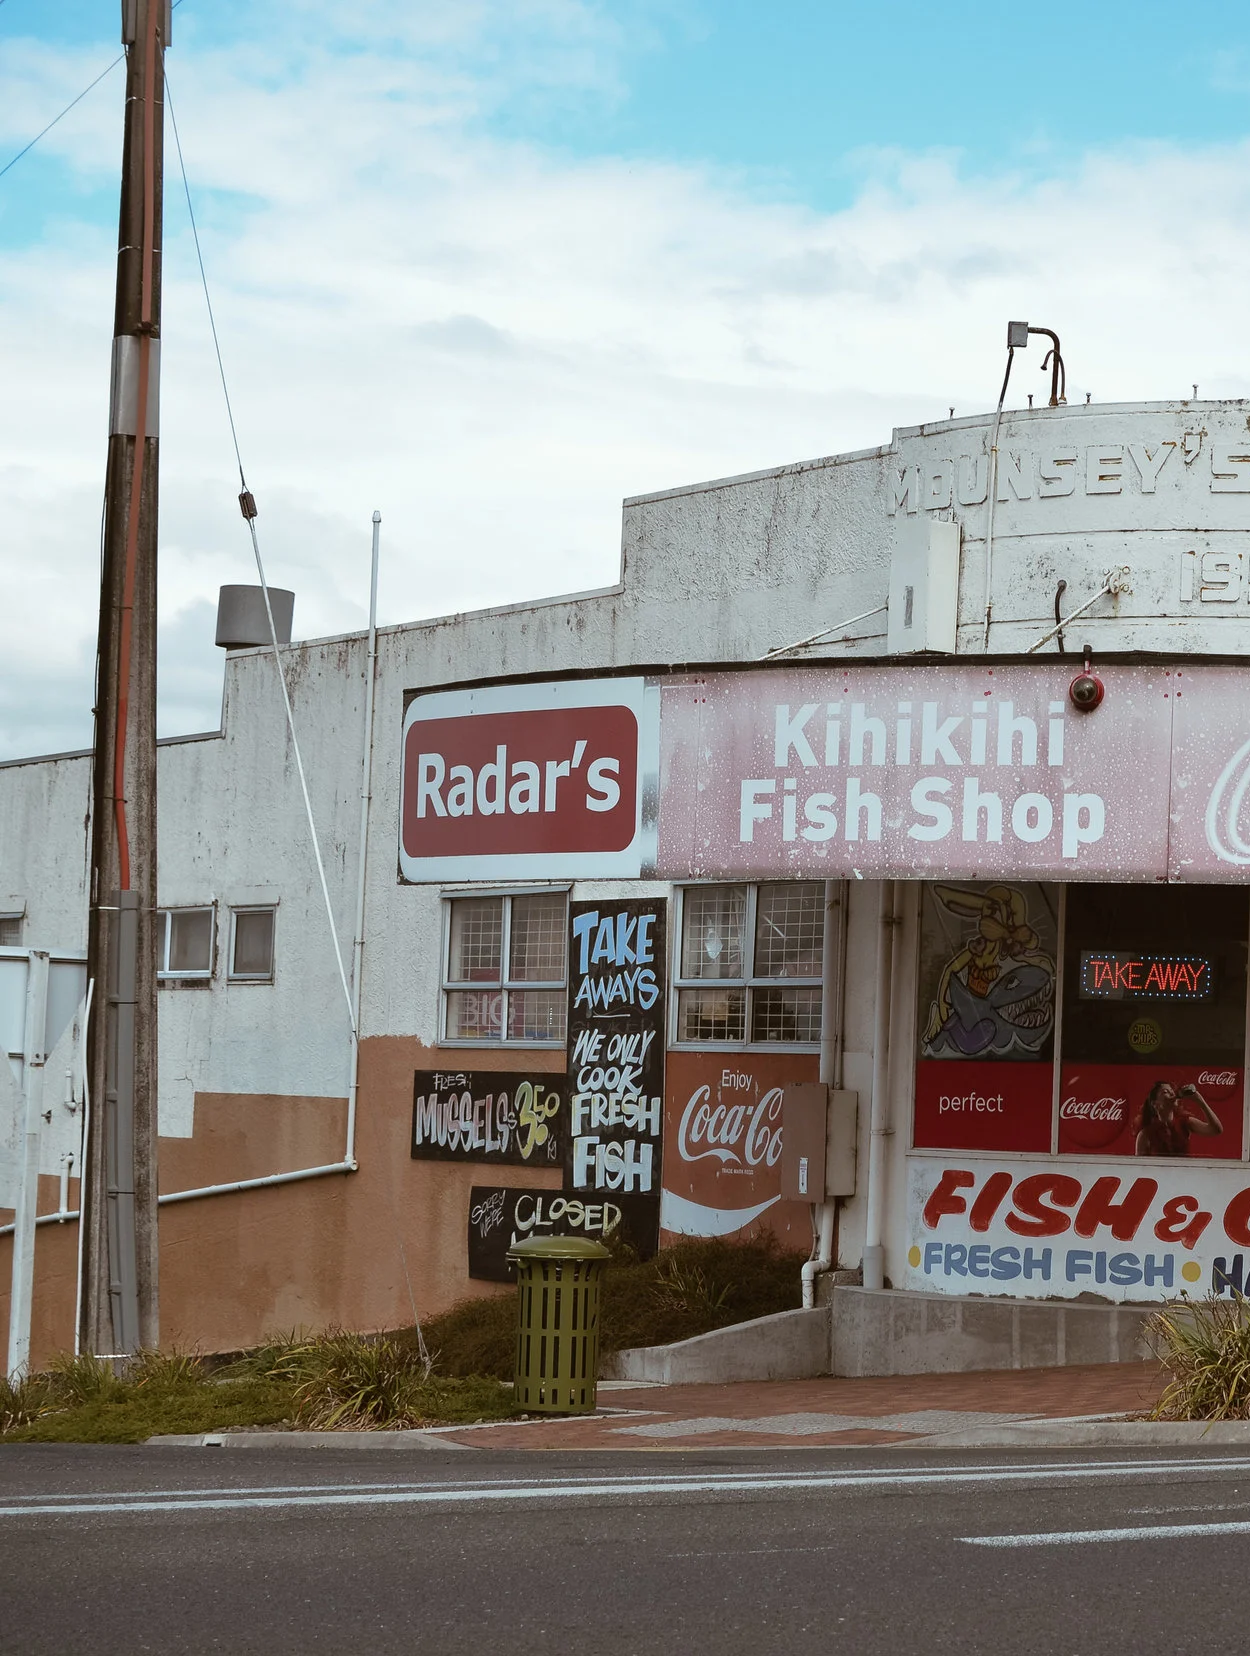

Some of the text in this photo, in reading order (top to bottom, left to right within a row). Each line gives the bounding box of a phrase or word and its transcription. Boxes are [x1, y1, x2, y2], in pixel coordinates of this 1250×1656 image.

[775, 700, 1065, 767] Kihikihi
[416, 739, 621, 818] Radar's
[739, 776, 1105, 859] Fish Shop
[573, 910, 657, 974] TAKE
[573, 966, 660, 1011] AWAYS
[1090, 961, 1206, 991] TAKE AWAY
[572, 1028, 656, 1066] WE ONLY
[1130, 1032, 1160, 1047] CHIPS
[577, 1065, 643, 1097] COOK
[721, 1069, 752, 1091] Enjoy
[1198, 1071, 1239, 1085] Coca-Cola
[416, 1091, 510, 1153] MUSSELS
[571, 1092, 661, 1137] FRESH
[678, 1084, 784, 1167] Coca-Co
[939, 1091, 1003, 1115] perfect
[1059, 1096, 1127, 1121] Coca-Cola
[573, 1136, 653, 1192] FISH
[470, 1190, 506, 1225] SORRY
[515, 1195, 622, 1236] CLOSED
[922, 1169, 1159, 1242] FISH
[1154, 1195, 1213, 1250] &
[923, 1242, 1052, 1281] FRESH
[1065, 1249, 1175, 1288] FISH
